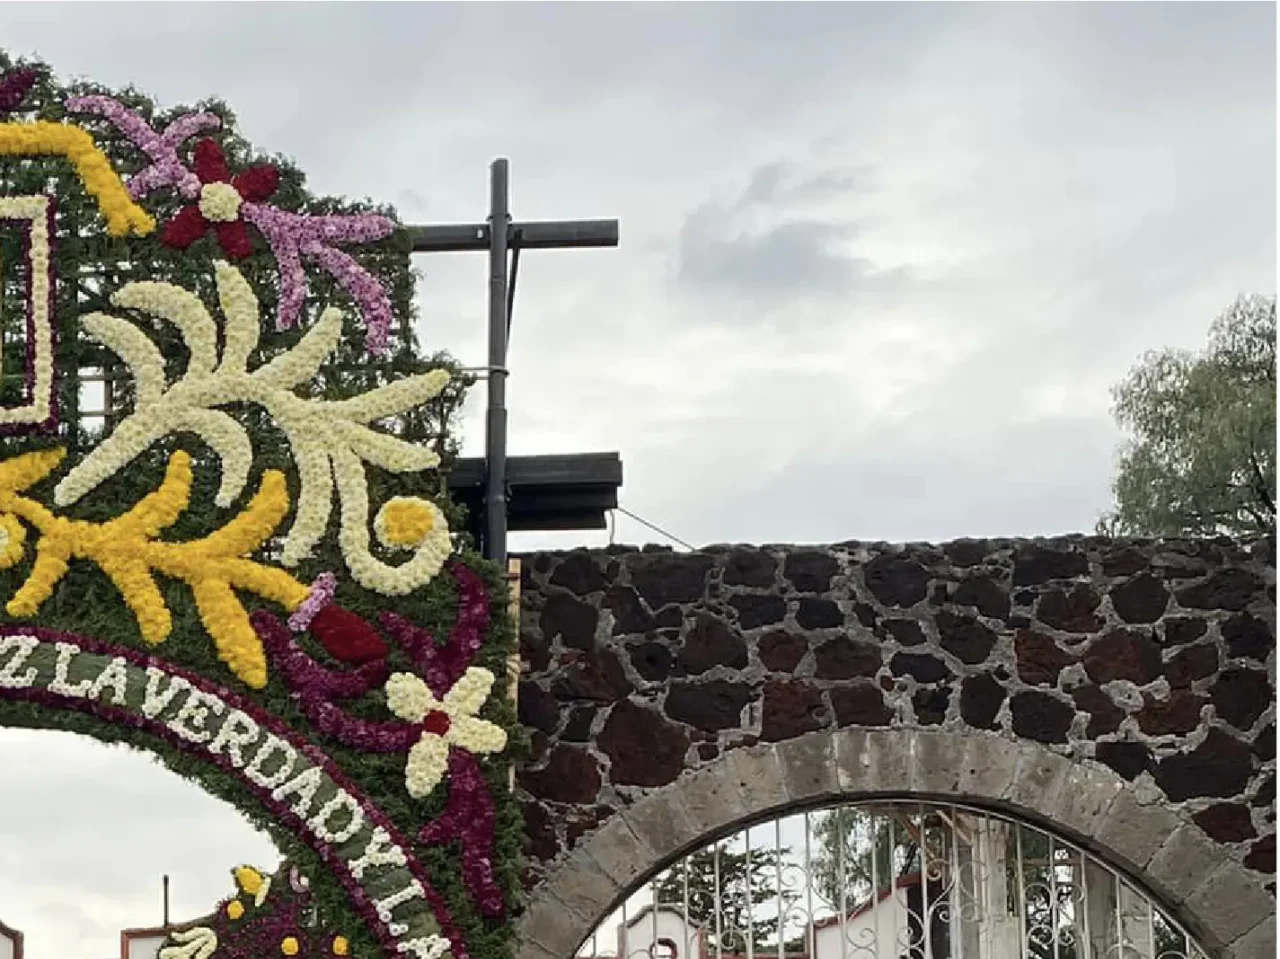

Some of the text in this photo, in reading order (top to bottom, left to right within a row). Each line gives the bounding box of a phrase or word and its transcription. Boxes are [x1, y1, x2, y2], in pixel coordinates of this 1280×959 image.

[47, 641, 128, 706] LA
[139, 666, 366, 844] VERDAD
[348, 825, 407, 879] Y
